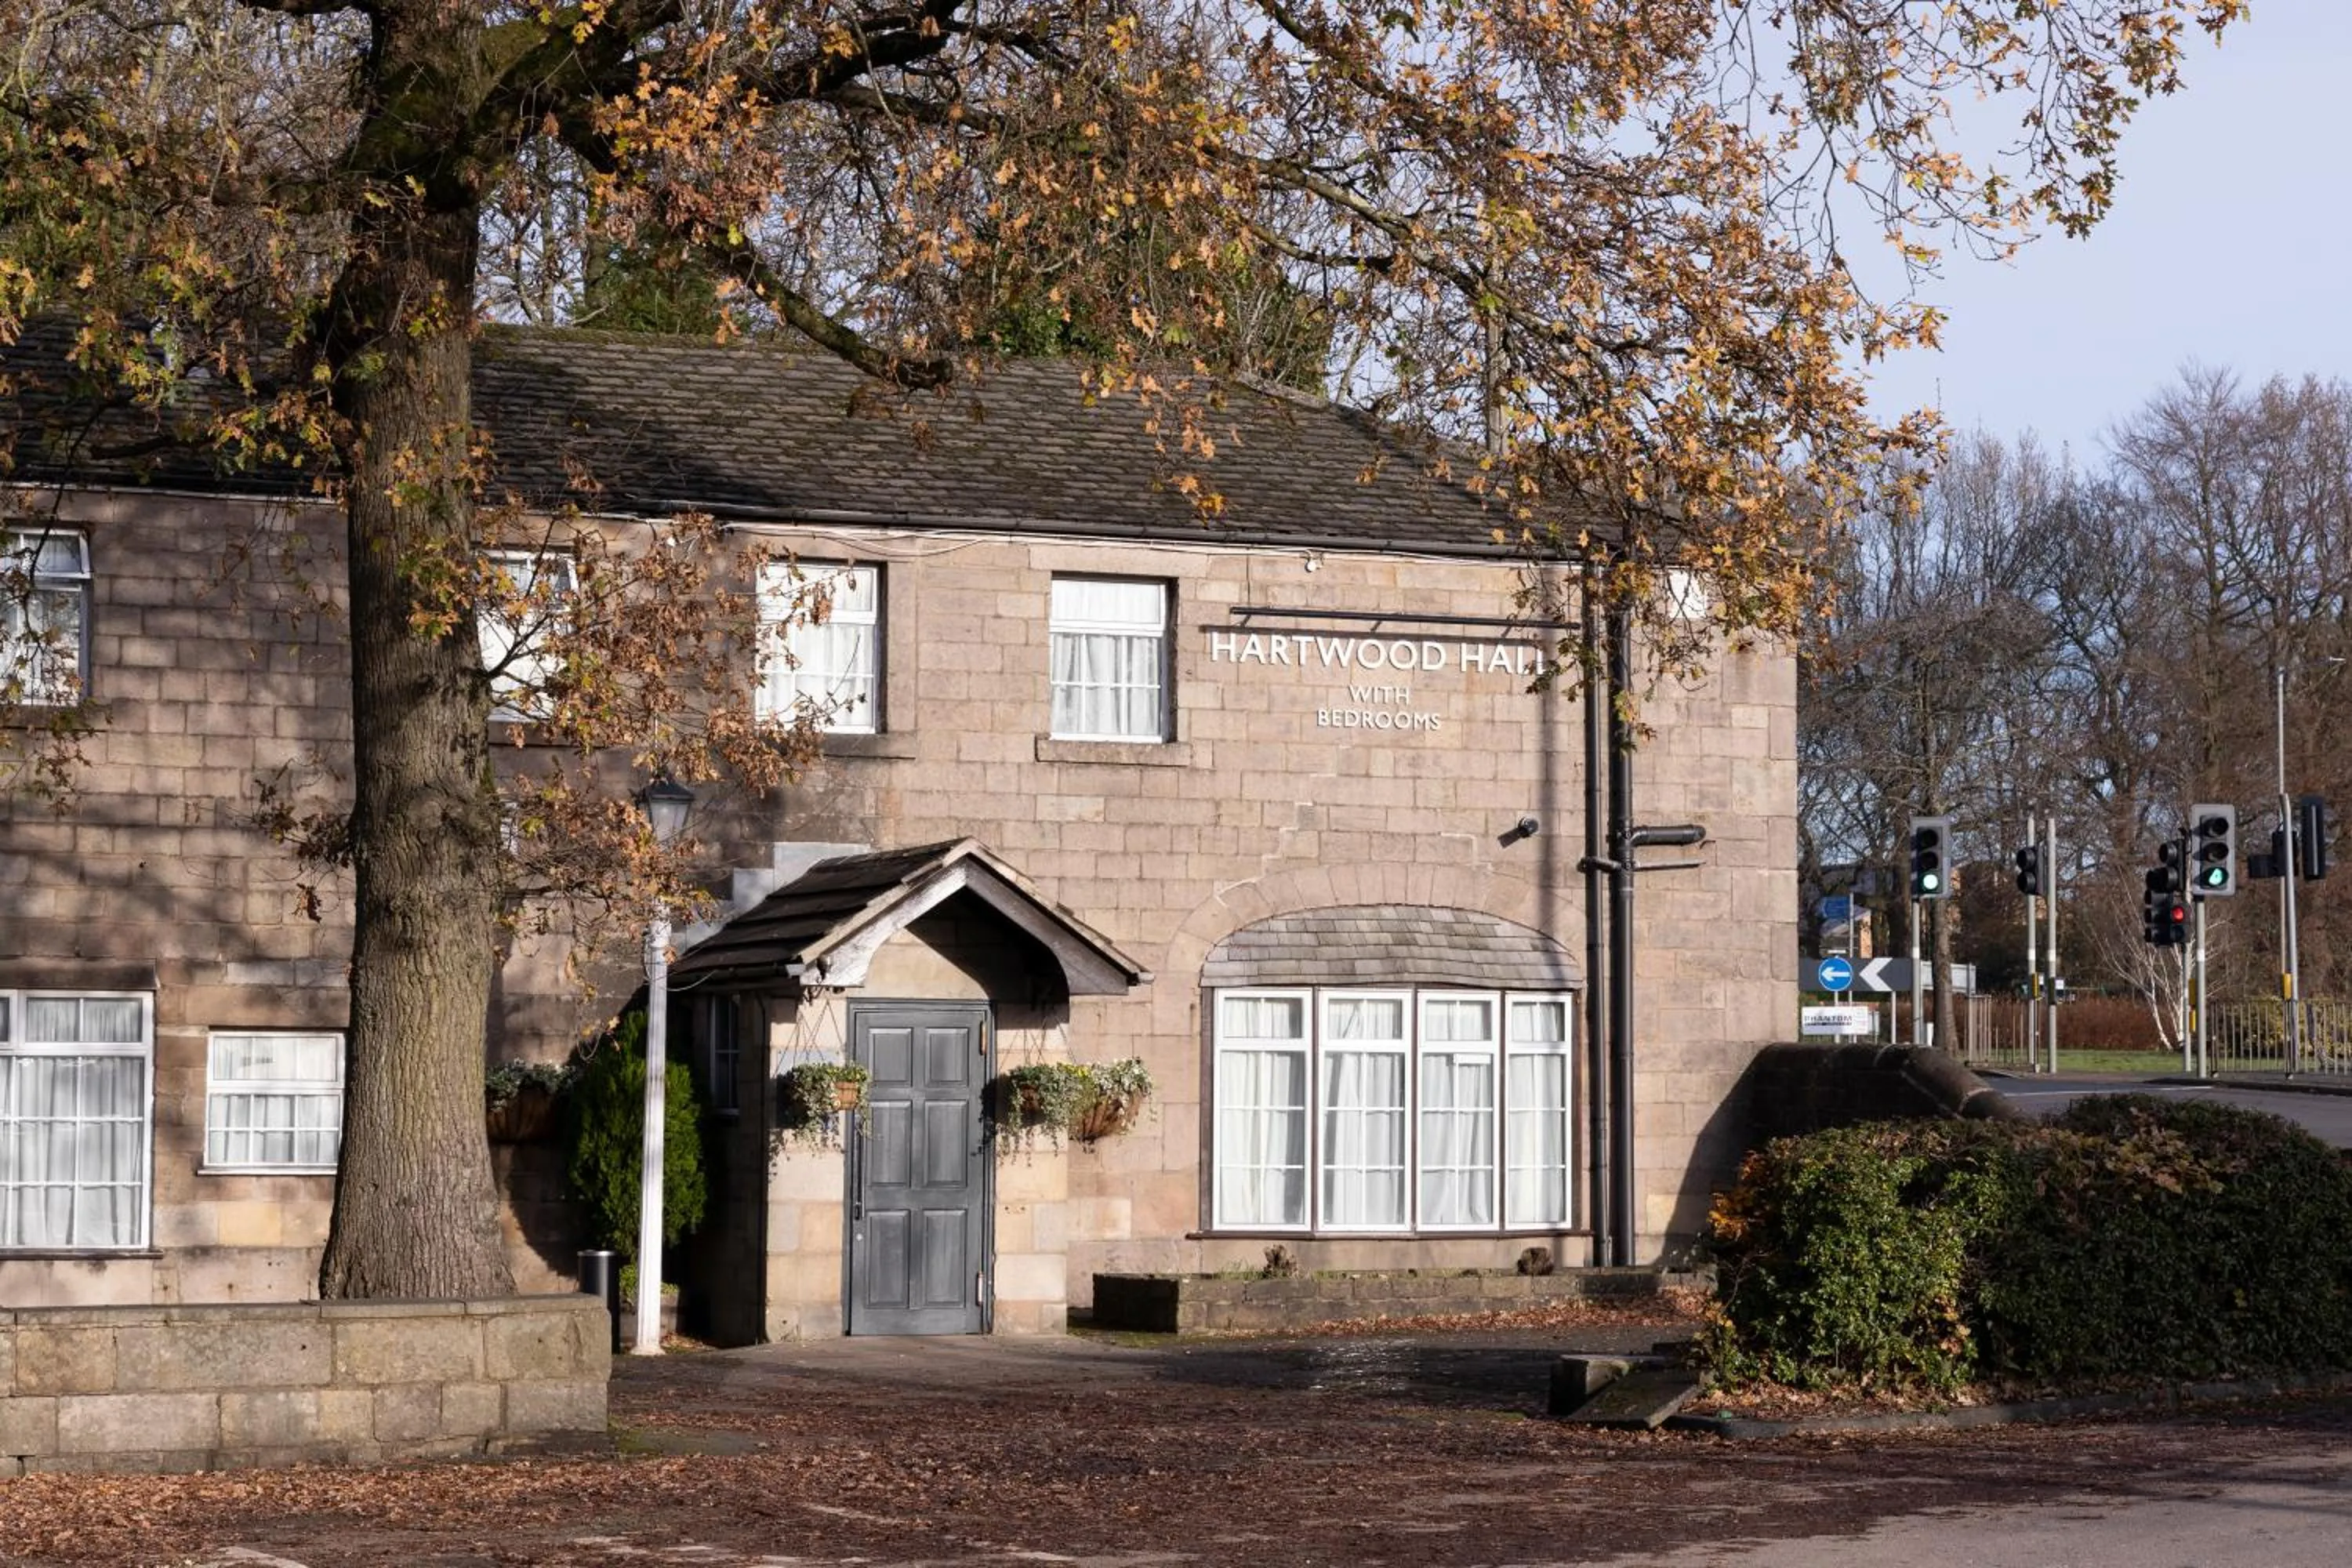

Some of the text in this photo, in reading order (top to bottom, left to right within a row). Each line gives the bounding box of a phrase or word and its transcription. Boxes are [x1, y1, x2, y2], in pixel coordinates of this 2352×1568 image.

[1210, 630, 1446, 670] HARTWOOD
[1348, 684, 1410, 705] WITH
[1317, 709, 1441, 730] BEDROOMS
